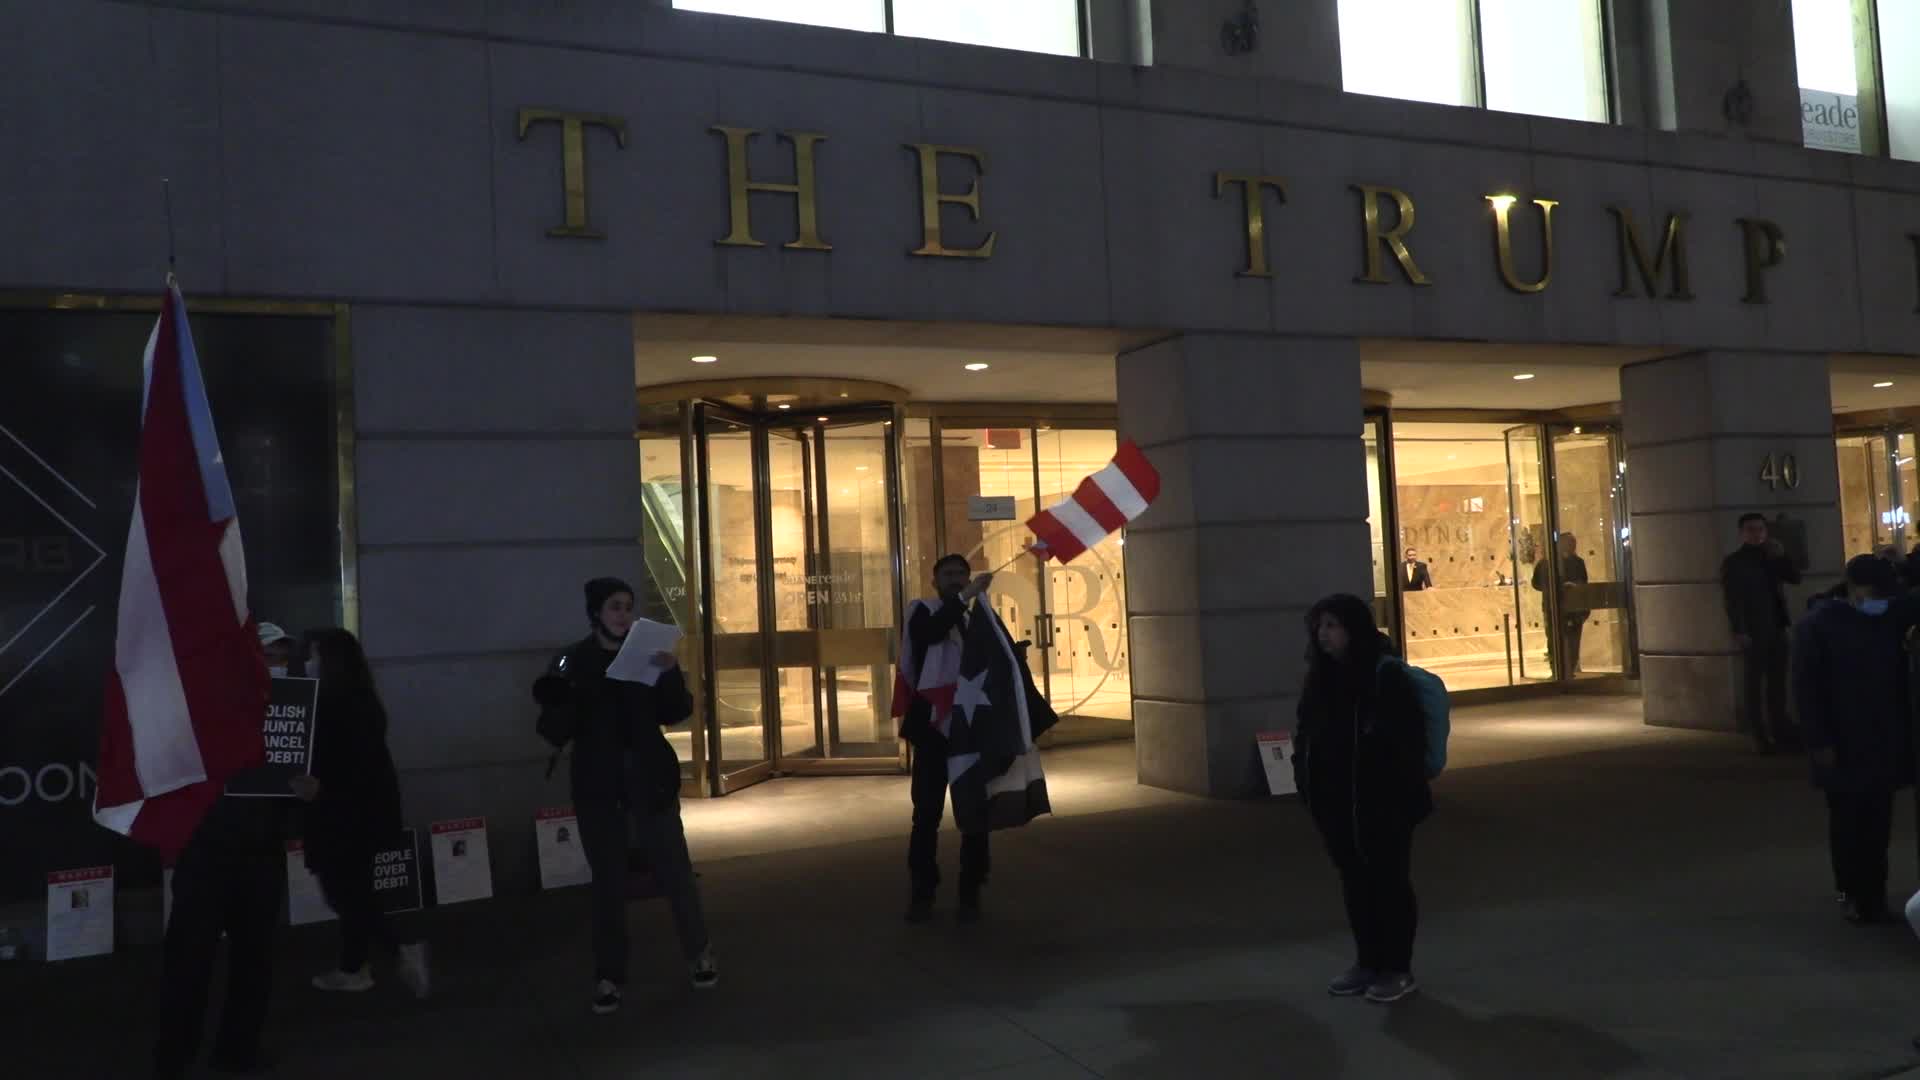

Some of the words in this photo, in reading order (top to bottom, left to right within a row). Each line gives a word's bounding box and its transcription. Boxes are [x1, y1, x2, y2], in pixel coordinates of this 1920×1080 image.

[516, 106, 998, 259] THE
[1213, 170, 1786, 304] TRUMP
[1761, 453, 1800, 490] 40
[264, 719, 305, 734] JUNTA
[374, 864, 406, 878] OVER
[374, 876, 408, 891] DEBT!
